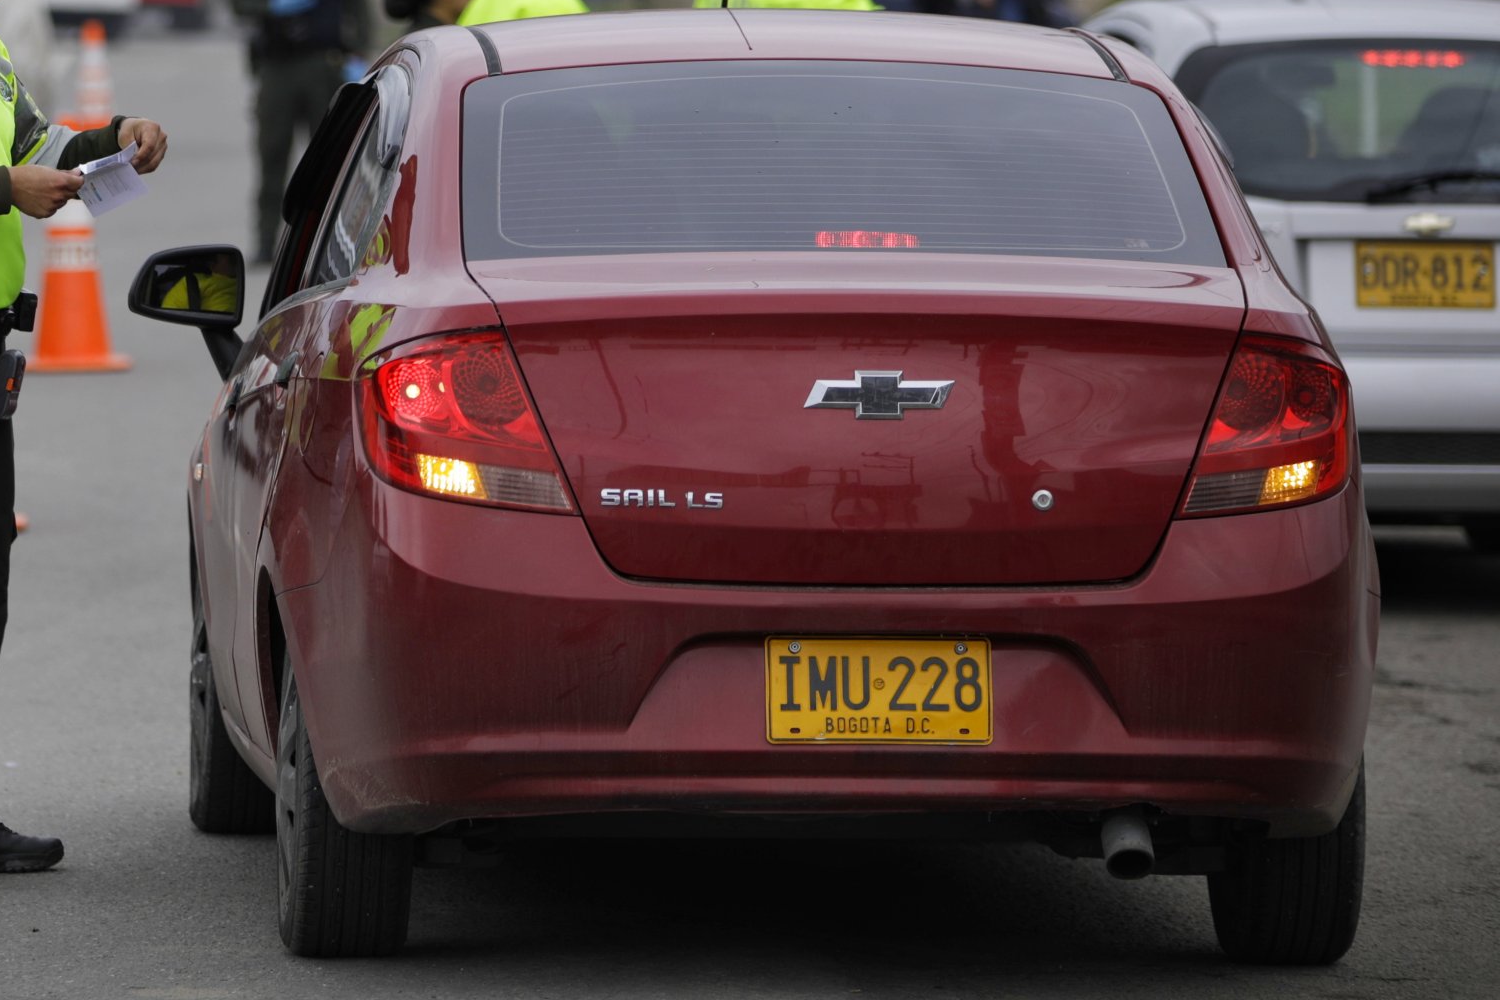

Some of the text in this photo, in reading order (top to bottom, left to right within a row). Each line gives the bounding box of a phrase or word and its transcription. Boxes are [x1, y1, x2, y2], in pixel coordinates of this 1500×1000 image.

[601, 488, 723, 508] SAIL LS
[825, 716, 935, 734] BOGOTA D.C.
